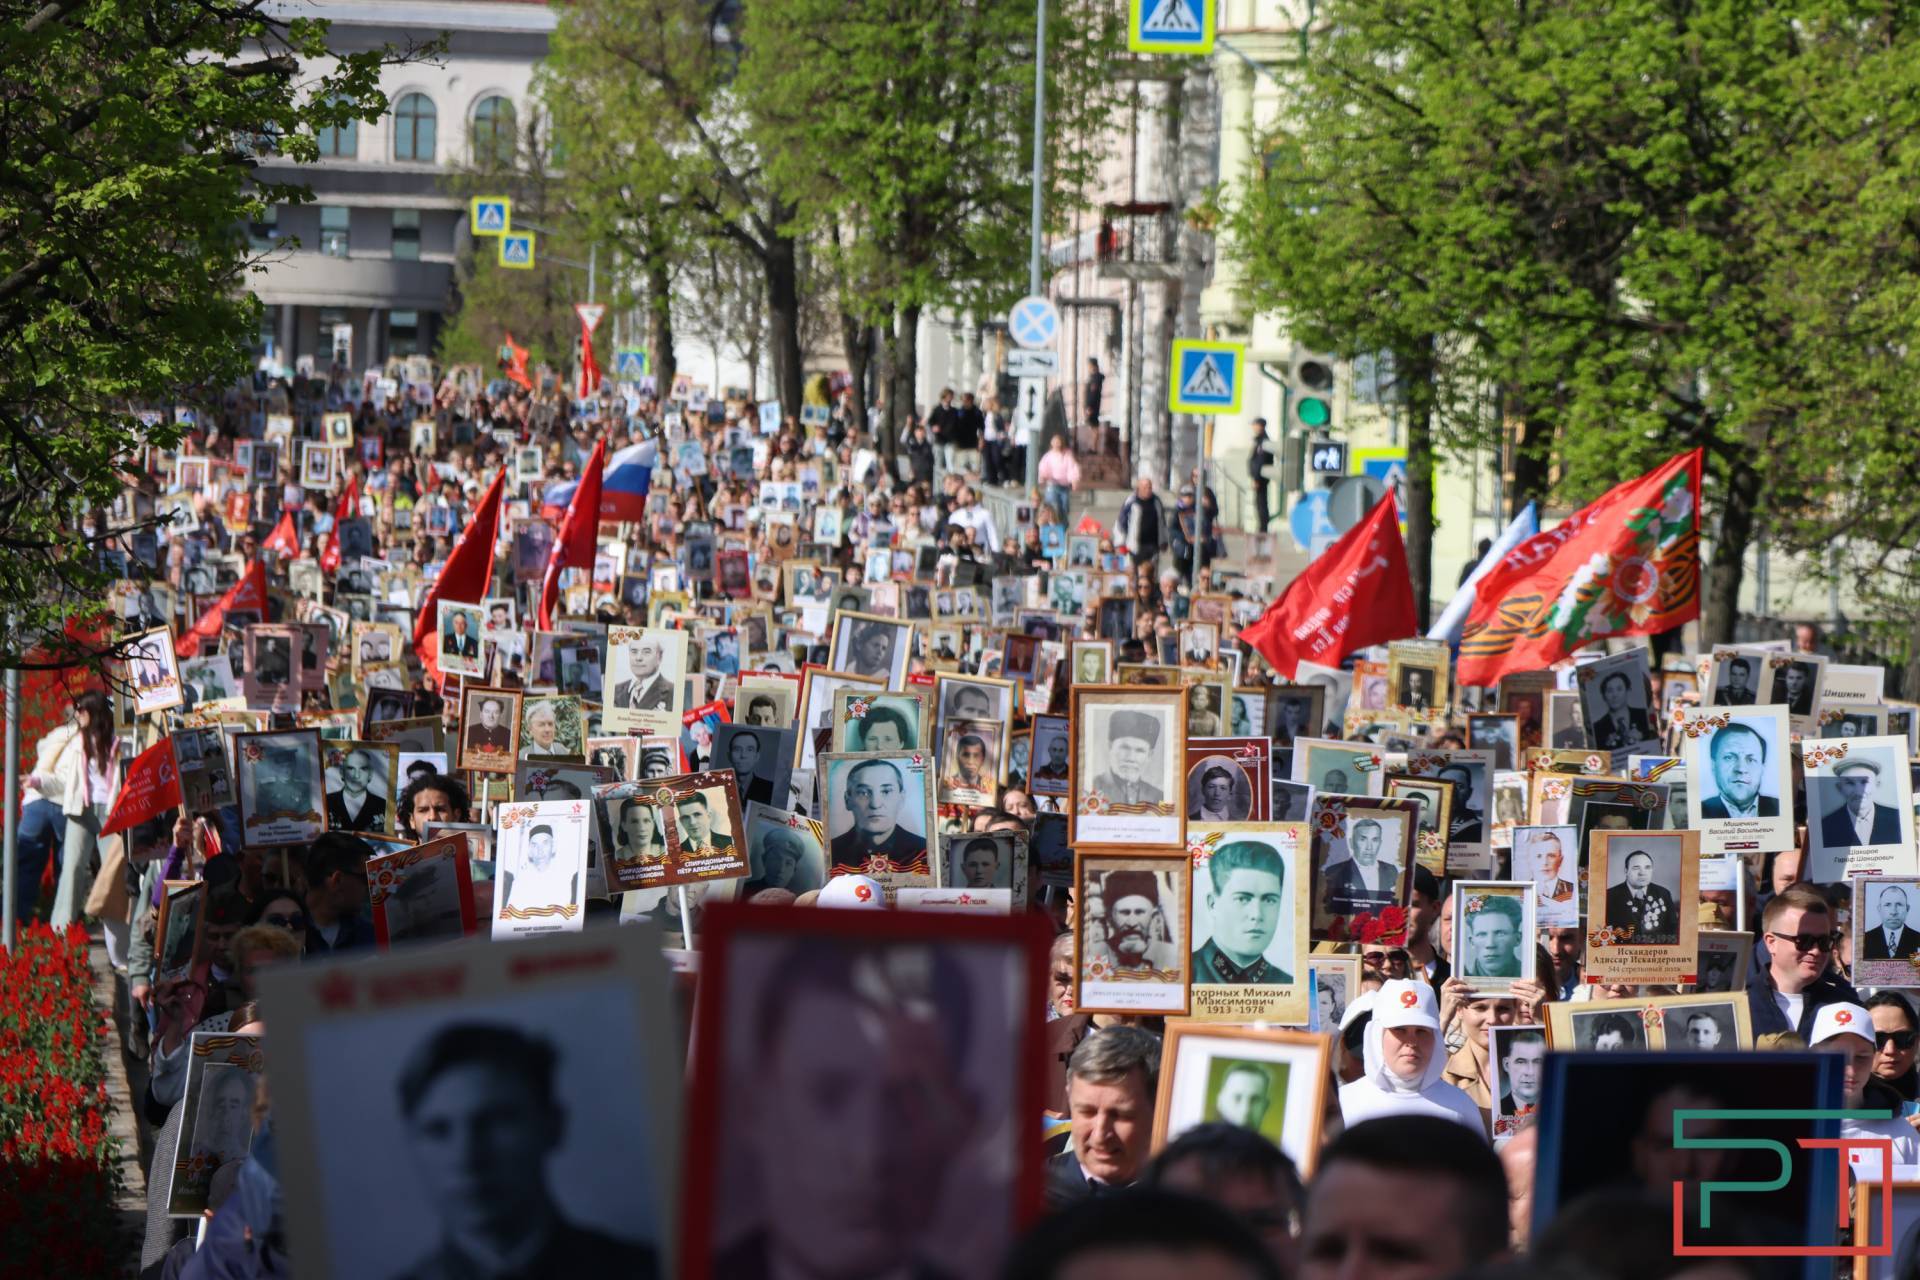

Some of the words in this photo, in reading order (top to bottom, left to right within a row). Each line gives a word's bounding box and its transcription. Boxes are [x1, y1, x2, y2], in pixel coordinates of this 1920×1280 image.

[1617, 948, 1668, 957] Искандеров
[1631, 956, 1692, 966] Искандерович
[1244, 988, 1291, 997] Михаил
[1197, 998, 1274, 1006] Максимович
